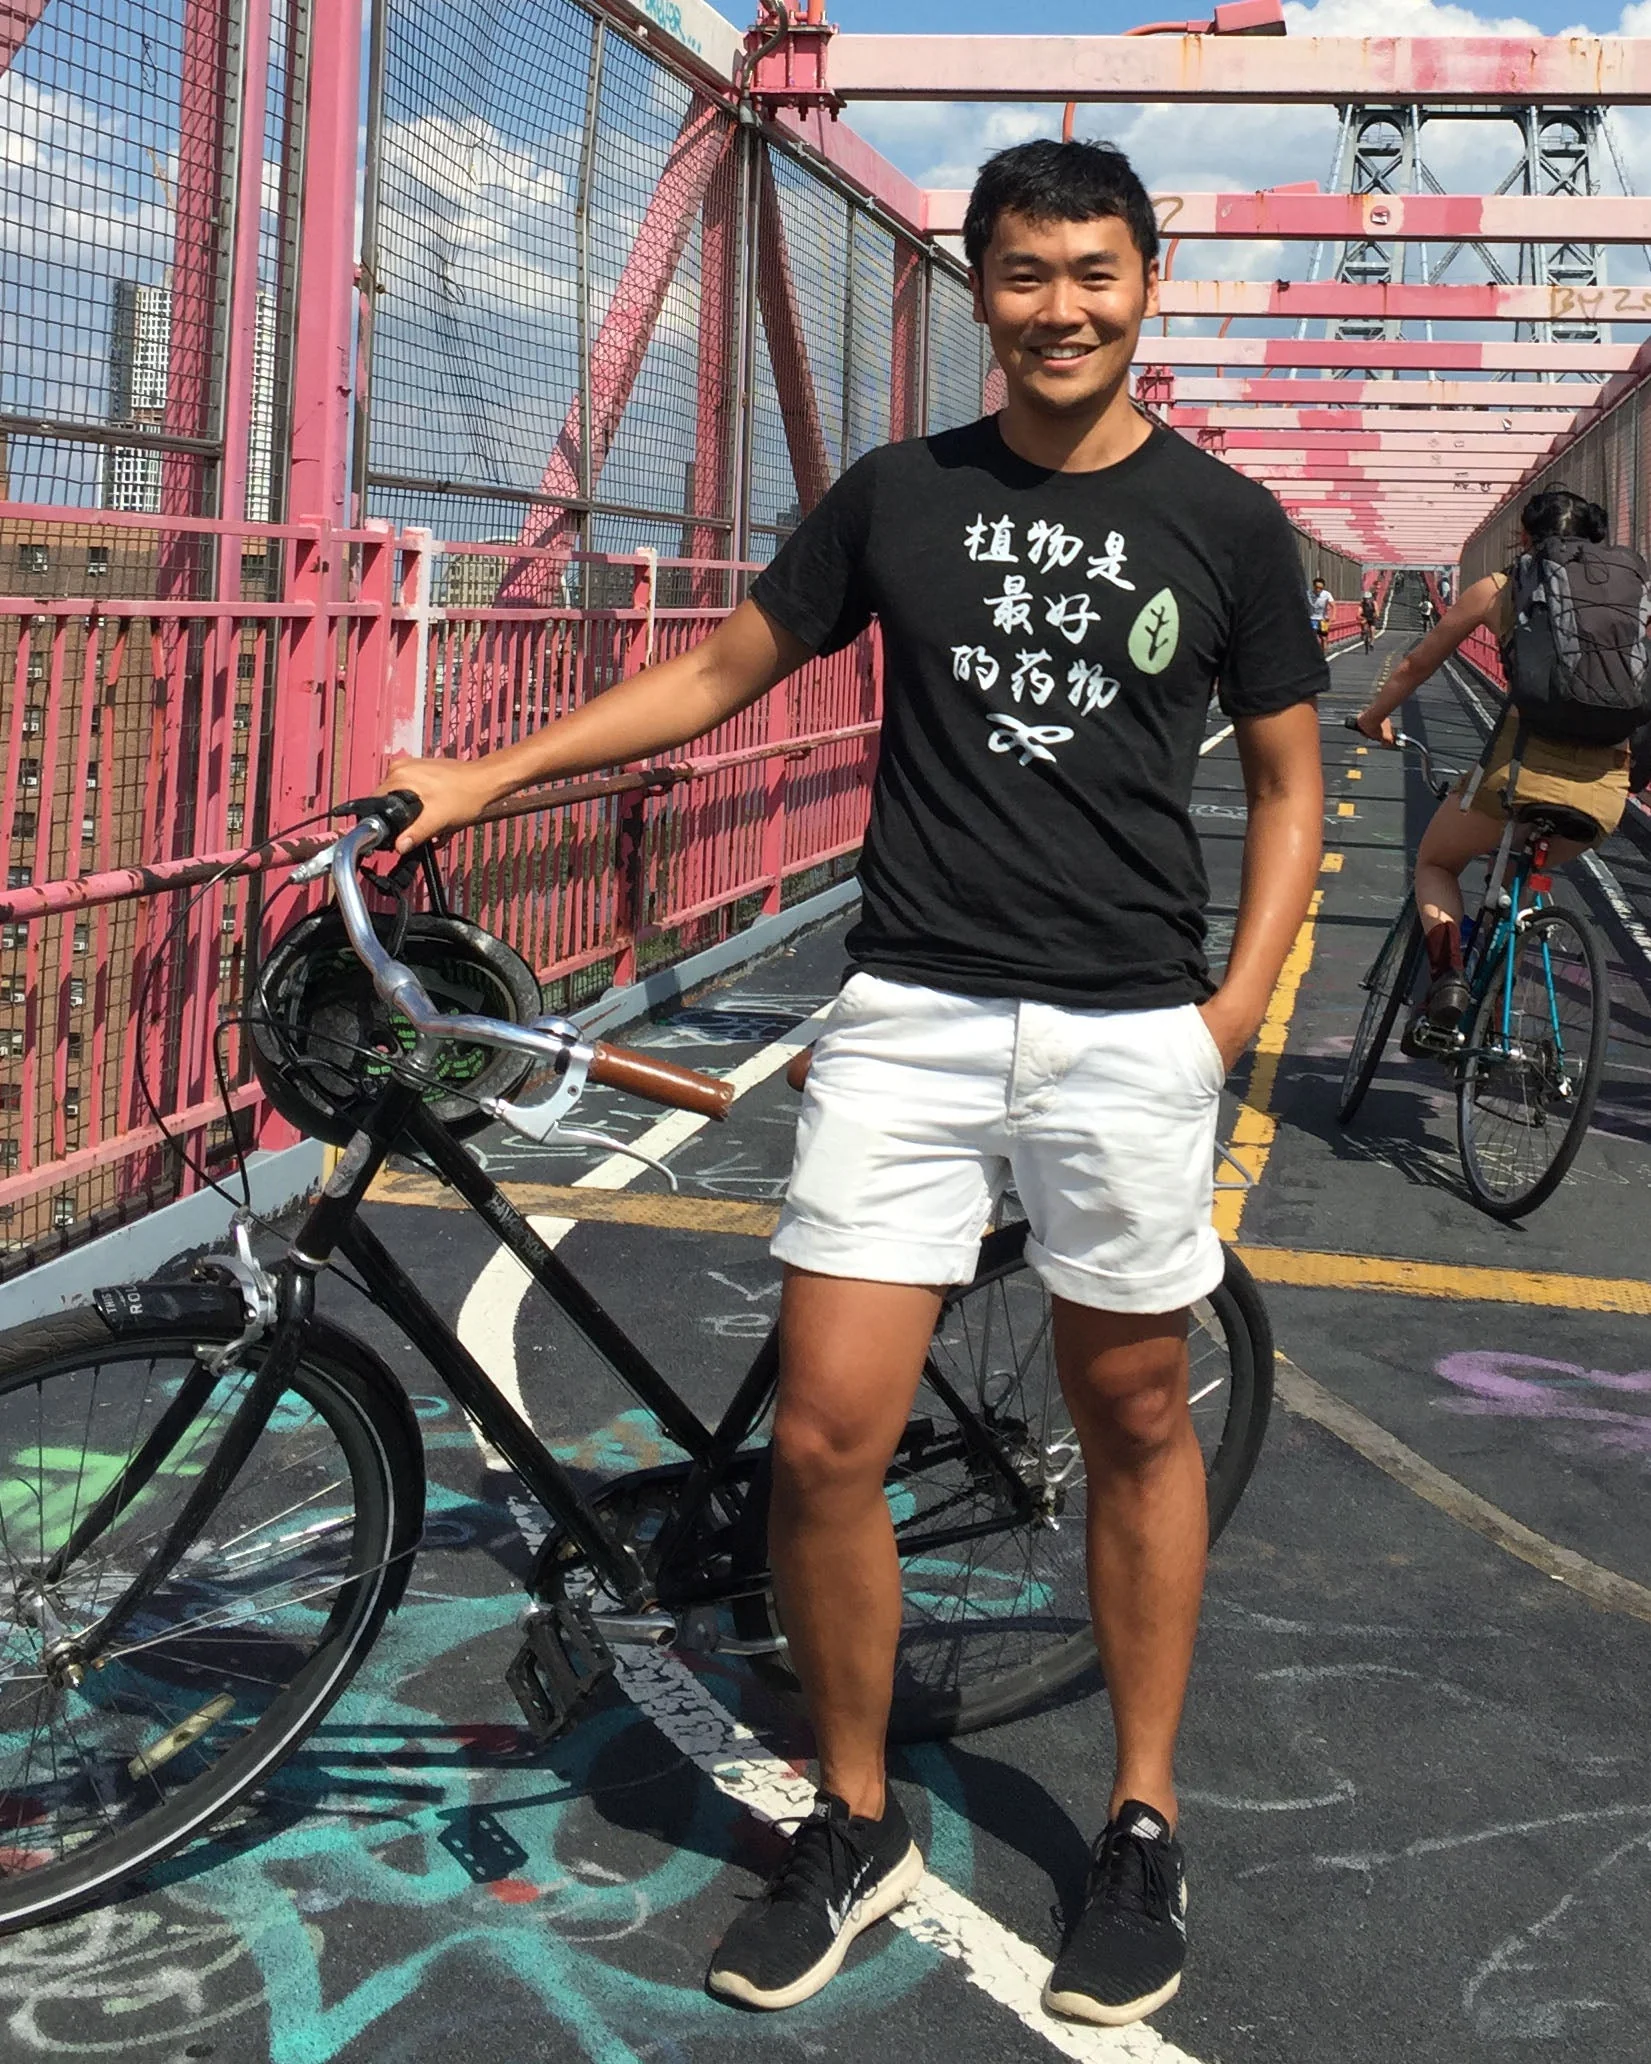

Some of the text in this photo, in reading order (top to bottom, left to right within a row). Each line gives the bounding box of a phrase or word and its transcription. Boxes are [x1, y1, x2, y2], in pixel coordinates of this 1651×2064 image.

[963, 512, 1136, 591] 植物是
[983, 574, 1102, 645] 最好
[950, 644, 1121, 717] 的药物
